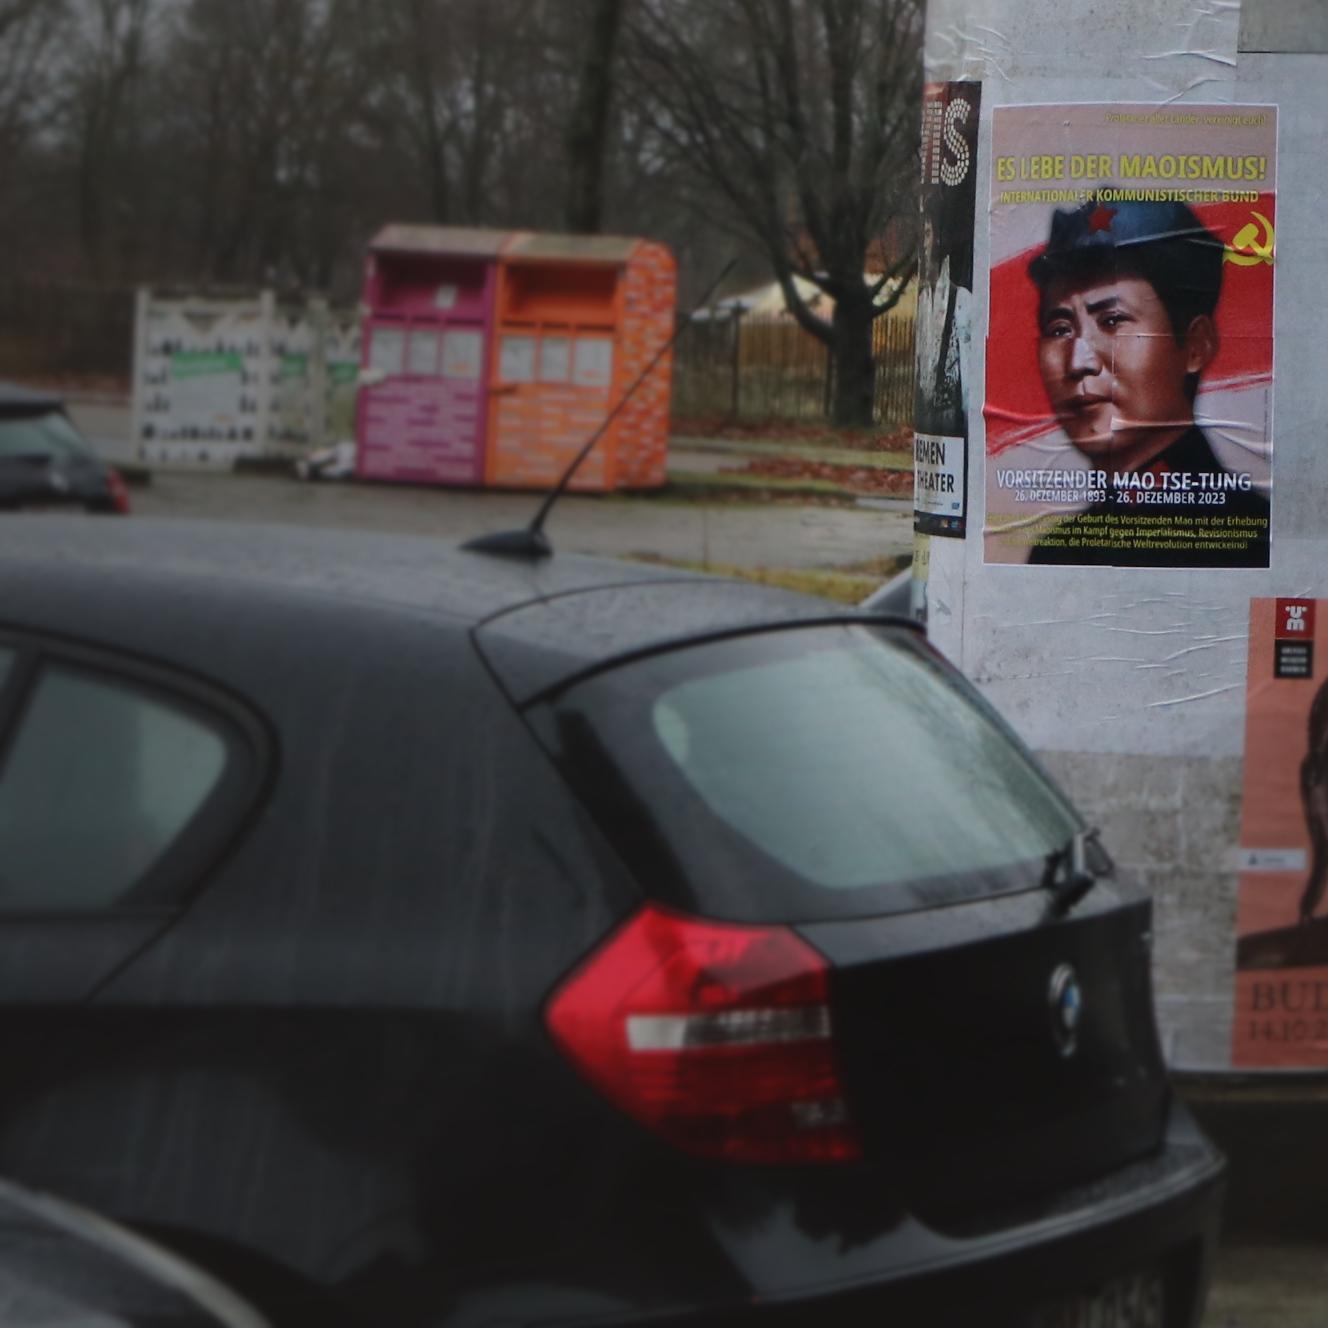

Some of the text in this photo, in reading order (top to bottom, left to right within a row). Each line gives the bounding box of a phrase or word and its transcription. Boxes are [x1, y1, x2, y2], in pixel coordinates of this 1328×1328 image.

[996, 155, 1266, 181] ES LEBE DER MAOISMUS!
[1096, 188, 1221, 203] KOMMUNISTISCHER
[1223, 189, 1259, 203] BUND
[997, 470, 1252, 491] VORSITZENDER MAO TSE-TUNG
[1015, 490, 1028, 502] 26.
[1029, 490, 1079, 503] DEZEMBER
[1082, 490, 1106, 503] 1893
[1117, 491, 1133, 504] 26.
[1136, 492, 1195, 504] DEZEMBER
[1198, 492, 1226, 505] 2023
[1077, 514, 1103, 524] Geburt
[1105, 514, 1119, 524] des
[1120, 515, 1172, 526] Vorsitzenden
[1174, 516, 1193, 526] Mao
[1195, 516, 1209, 526] mit
[1210, 516, 1225, 526] der
[1227, 516, 1268, 529] Erhebung
[1083, 525, 1108, 537] Kampf
[1110, 528, 1135, 539] gegen
[1136, 527, 1196, 539] Imperialismus,
[1199, 528, 1258, 539] Revisionismus
[1081, 538, 1131, 549] Proletarische
[1133, 538, 1193, 550] Weltrevolution
